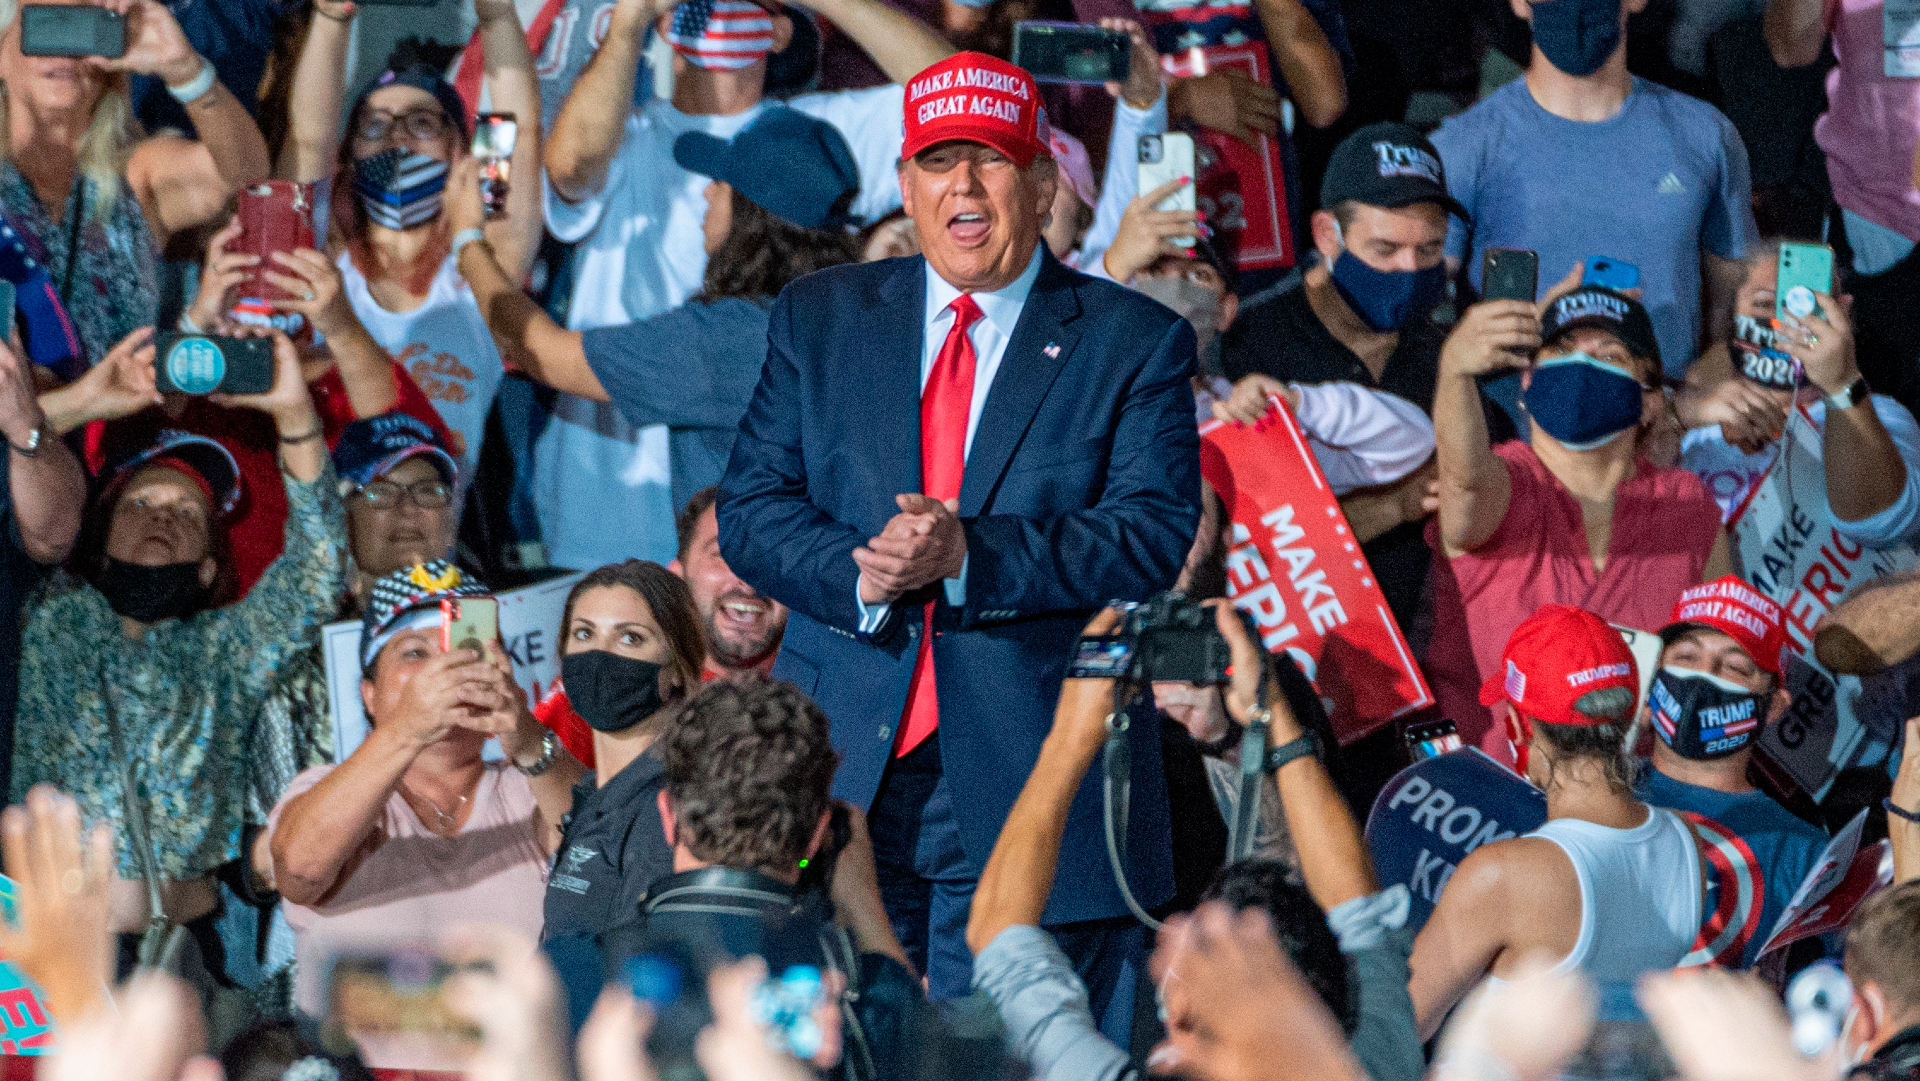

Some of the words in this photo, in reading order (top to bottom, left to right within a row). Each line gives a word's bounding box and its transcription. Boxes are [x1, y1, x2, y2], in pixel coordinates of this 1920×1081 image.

[909, 71, 953, 102] MAKE
[954, 68, 1029, 100] AMERICA
[918, 95, 967, 125] GREAT
[969, 95, 1021, 124] AGAIN
[1555, 291, 1630, 316] Trump
[1261, 504, 1349, 636] MAKE
[1681, 584, 1718, 602] MAKE
[1717, 582, 1780, 626] AMERICA
[1784, 527, 1863, 656] ERIC
[1680, 602, 1723, 619] GREAT
[1721, 604, 1767, 640] AGAIN
[1566, 664, 1613, 687] TRUMP
[1698, 698, 1756, 729] TRUMP
[1778, 670, 1840, 749] GRE
[1705, 733, 1749, 754] 2020
